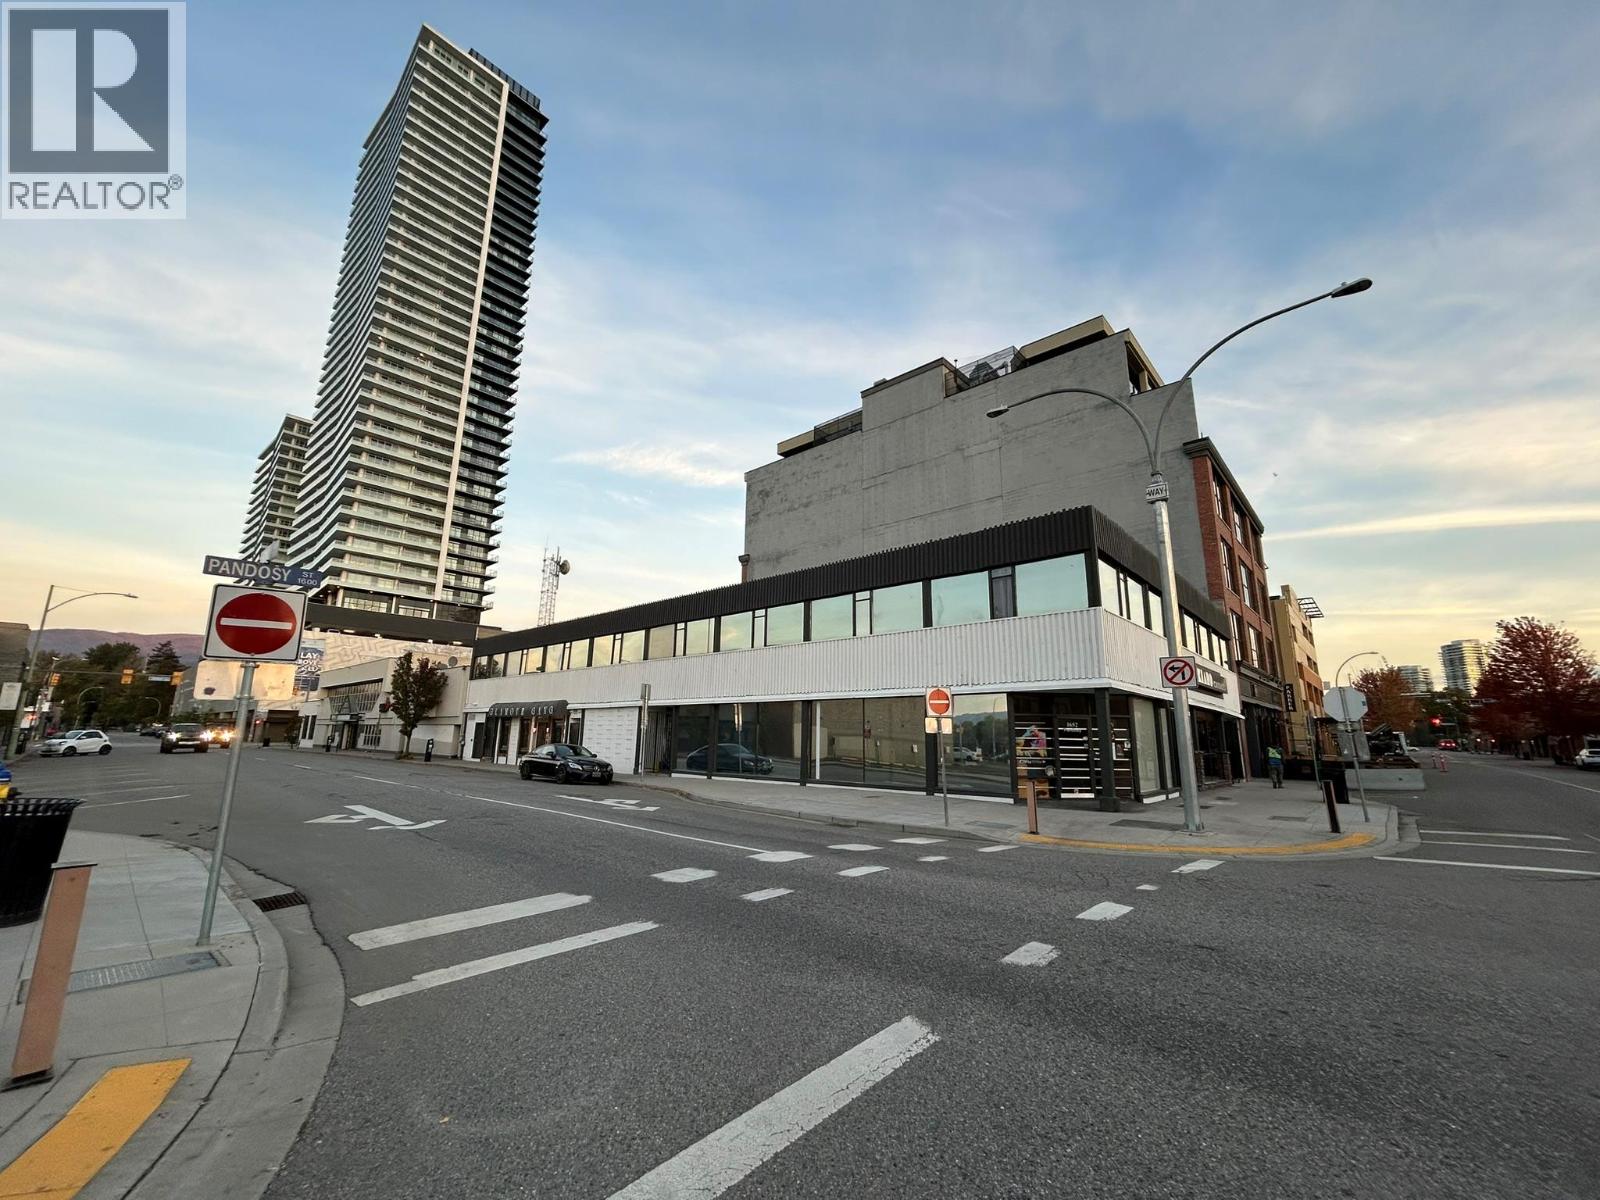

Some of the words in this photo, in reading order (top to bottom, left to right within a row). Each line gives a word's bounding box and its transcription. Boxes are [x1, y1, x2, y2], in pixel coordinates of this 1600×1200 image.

[208, 558, 292, 582] PANDOSY
[301, 571, 314, 579] ST
[298, 577, 318, 586] 1600
